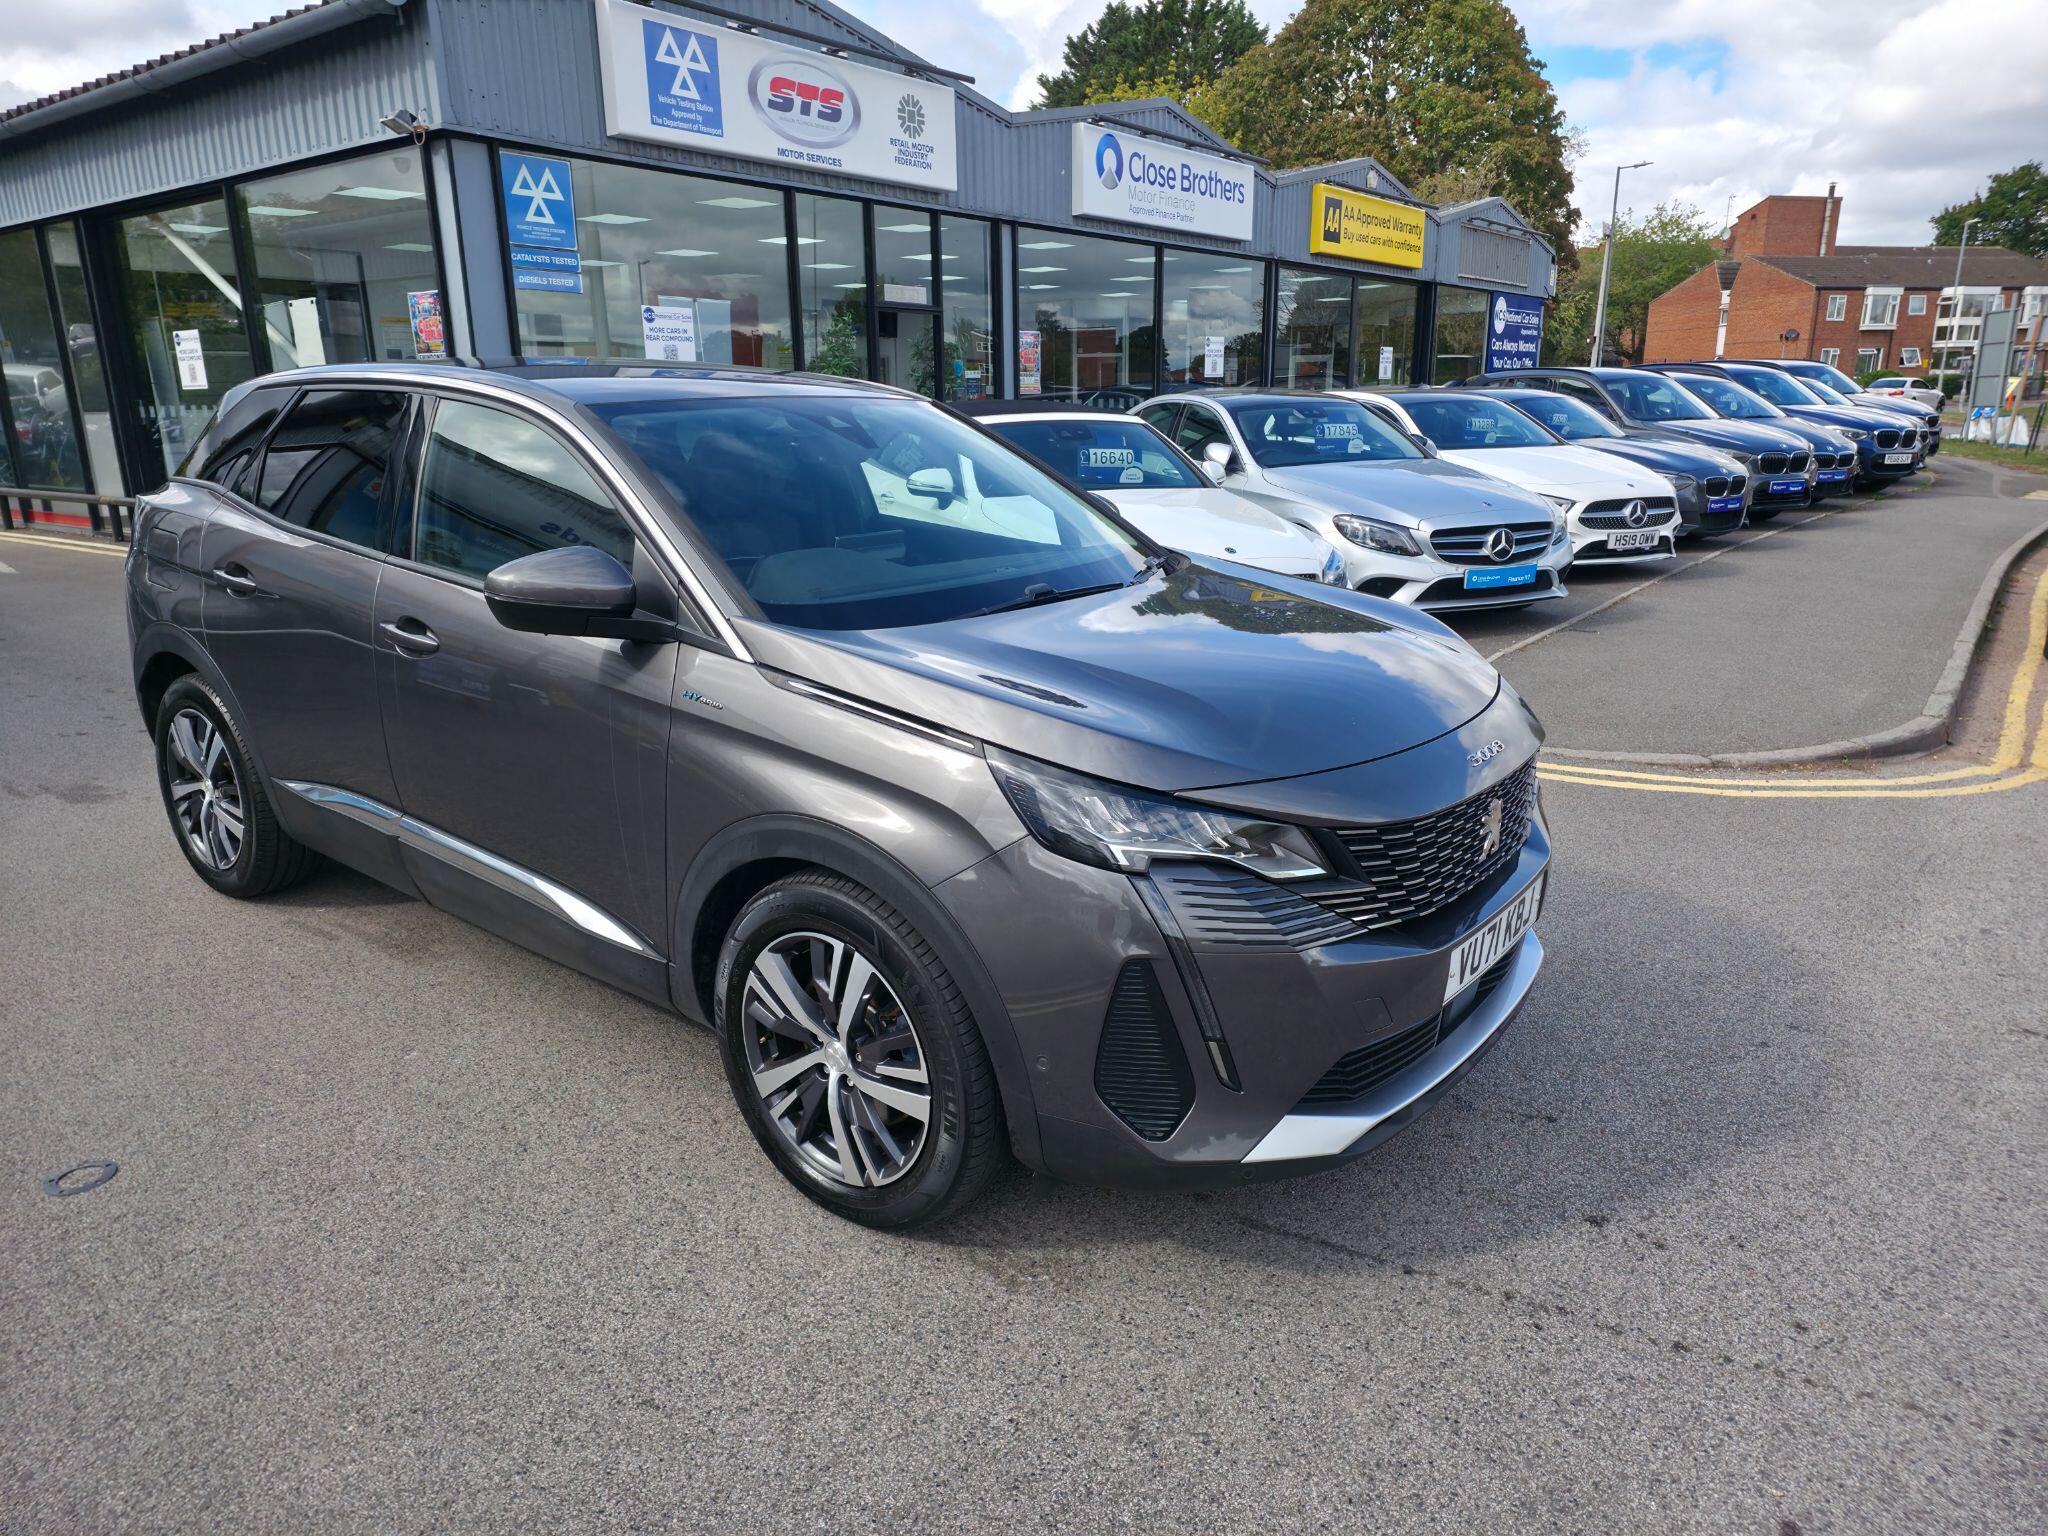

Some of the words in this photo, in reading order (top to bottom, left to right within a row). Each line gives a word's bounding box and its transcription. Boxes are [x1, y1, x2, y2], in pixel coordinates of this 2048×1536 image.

[658, 94, 677, 106] Vehicle
[677, 98, 696, 111] Testing
[696, 102, 714, 113] Station
[768, 76, 845, 123] STS
[671, 109, 696, 120] Approved
[696, 112, 703, 122] by
[652, 115, 663, 125] The
[663, 118, 692, 130] Department
[699, 125, 722, 136] Transport
[890, 138, 910, 149] RETAIL
[912, 142, 934, 154] MOTOR
[898, 148, 929, 161] INDUSTRY
[777, 147, 805, 161] MOTOR
[806, 153, 843, 167] SERVICES
[895, 156, 932, 170] FEDERATION
[1129, 151, 1177, 190] Close
[1181, 163, 1245, 204] Brothers
[1129, 185, 1157, 204] Motor
[1158, 190, 1196, 212] Finance
[1129, 204, 1156, 217] Approved
[1156, 207, 1176, 220] Finance
[1176, 211, 1196, 223] Partner
[1325, 206, 1340, 233] AA
[1343, 205, 1355, 221] AA
[1356, 208, 1391, 229] Approved
[1392, 216, 1423, 240] Warranty
[1343, 228, 1355, 243] Buy
[1355, 231, 1370, 244] used
[1370, 236, 1382, 246] cars
[1382, 236, 1394, 248] with
[1394, 239, 1421, 253] confidence
[511, 253, 549, 263] CATALYSTS
[551, 256, 577, 266] TESTED
[519, 275, 547, 285] DIESELS
[548, 277, 574, 287] TESTED
[1506, 311, 1523, 323] National
[1530, 314, 1539, 324] Sales
[1492, 338, 1502, 350] Cars
[1502, 339, 1518, 354] Always
[1493, 356, 1503, 368] Your
[1614, 534, 1638, 546] HS19
[1467, 740, 1504, 767] 3008
[1460, 917, 1502, 986] VU71
[1503, 885, 1536, 948] KBJ
